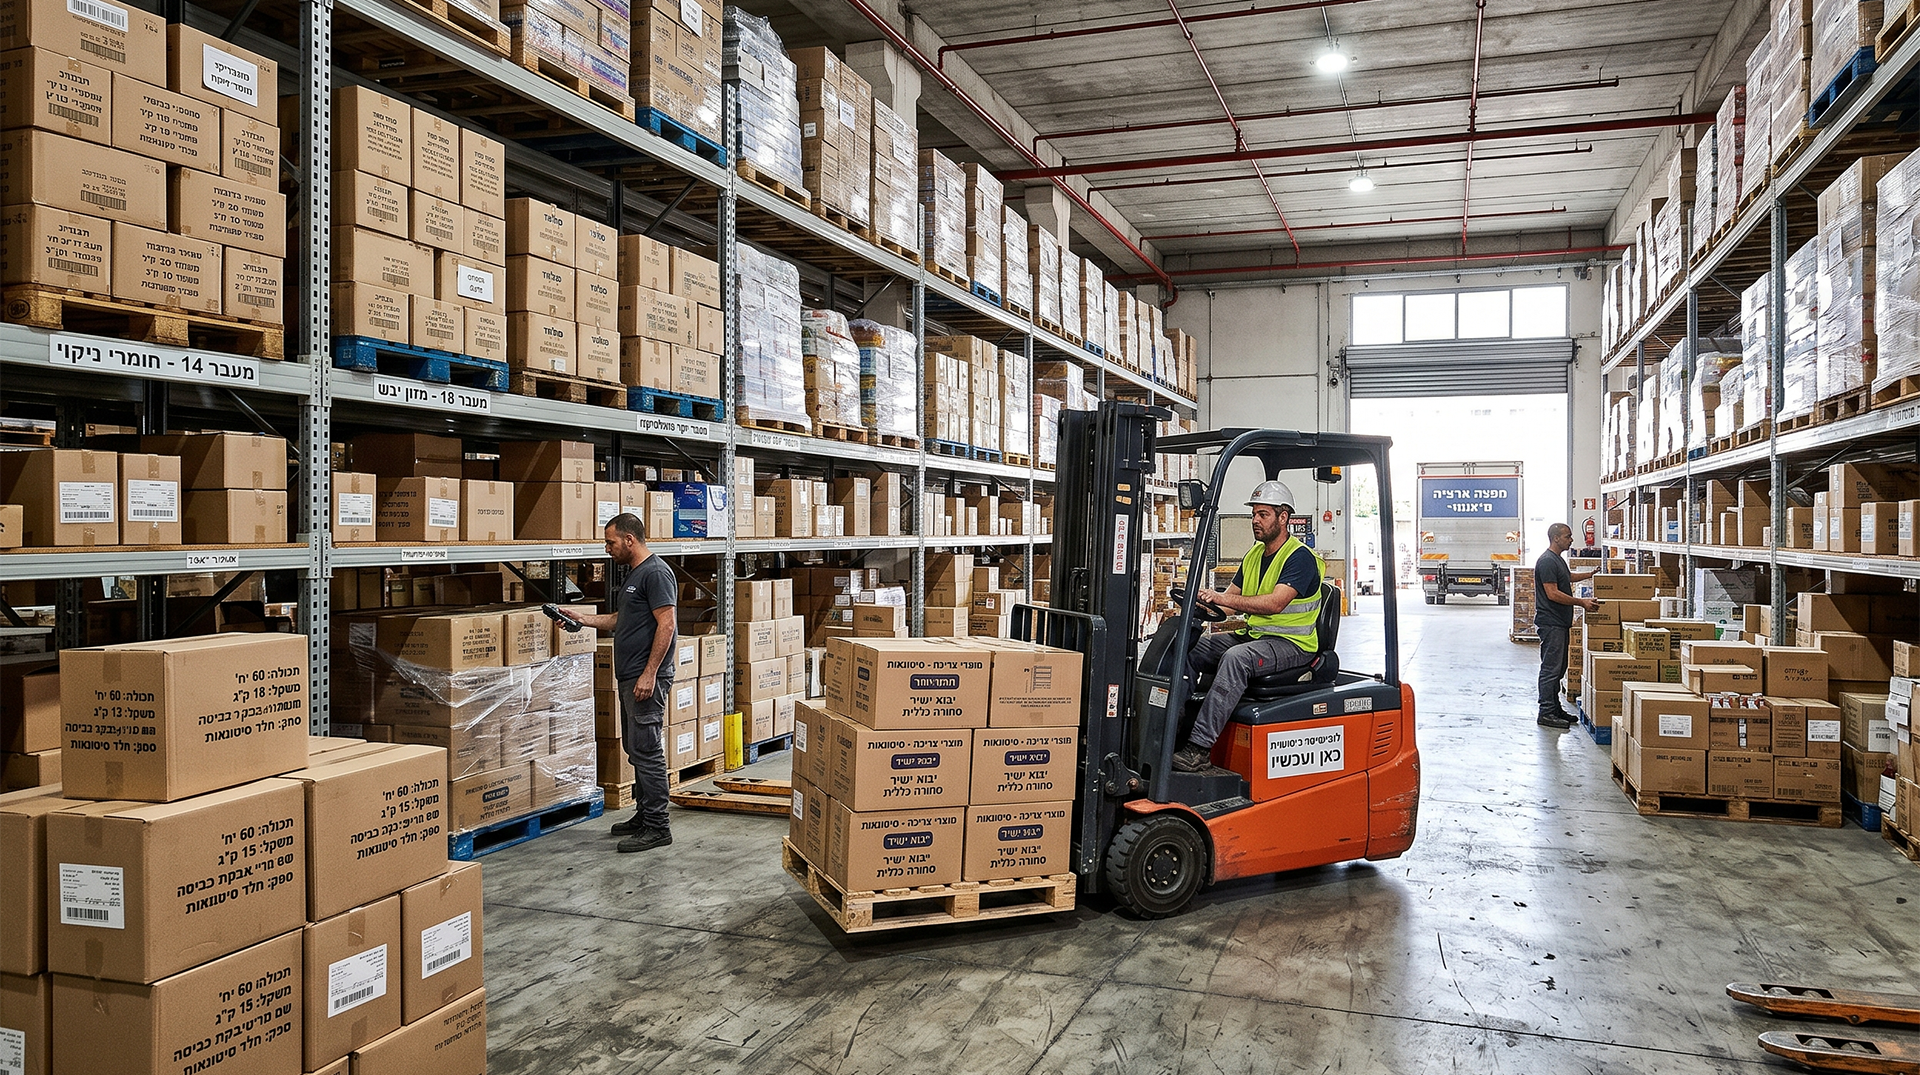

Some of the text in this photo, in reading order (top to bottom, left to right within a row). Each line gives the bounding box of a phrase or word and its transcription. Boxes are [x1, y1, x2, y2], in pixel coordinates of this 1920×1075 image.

[58, 344, 100, 363] ניקוי
[110, 350, 160, 368] חומרי
[182, 356, 203, 374] 14
[209, 362, 254, 380] מעבר
[378, 384, 400, 396] יבש
[406, 388, 428, 402] מזון
[440, 391, 454, 404] 18
[458, 395, 487, 408] מעבר
[252, 670, 264, 681] 60
[268, 667, 300, 679] תכולה:
[110, 690, 120, 700] 60
[123, 690, 154, 701] תכולה:
[254, 687, 265, 698] 18
[268, 683, 300, 698] משקל:
[111, 707, 122, 717] 13
[125, 707, 155, 720] משקל:
[1272, 750, 1340, 768] כאן ועכשיו
[890, 774, 937, 784] יבוא ישיר
[1004, 772, 1026, 780] ישיר
[397, 786, 408, 798] 60
[914, 786, 943, 796] סחורה
[399, 801, 410, 812] 15
[240, 826, 254, 840] 60
[258, 818, 294, 836] תכולה:
[242, 844, 256, 858] 15
[260, 836, 294, 854] משקל:
[997, 847, 1018, 856] ישיר
[883, 856, 905, 864] ישיר
[1019, 856, 1046, 866] סחורה
[907, 866, 936, 875] סחורה
[177, 878, 214, 898] כביסה
[238, 982, 252, 996] 60
[256, 986, 291, 1008] משקל:
[240, 998, 253, 1014] 15
[275, 1003, 292, 1018] שם
[174, 1038, 211, 1062] כביסה
